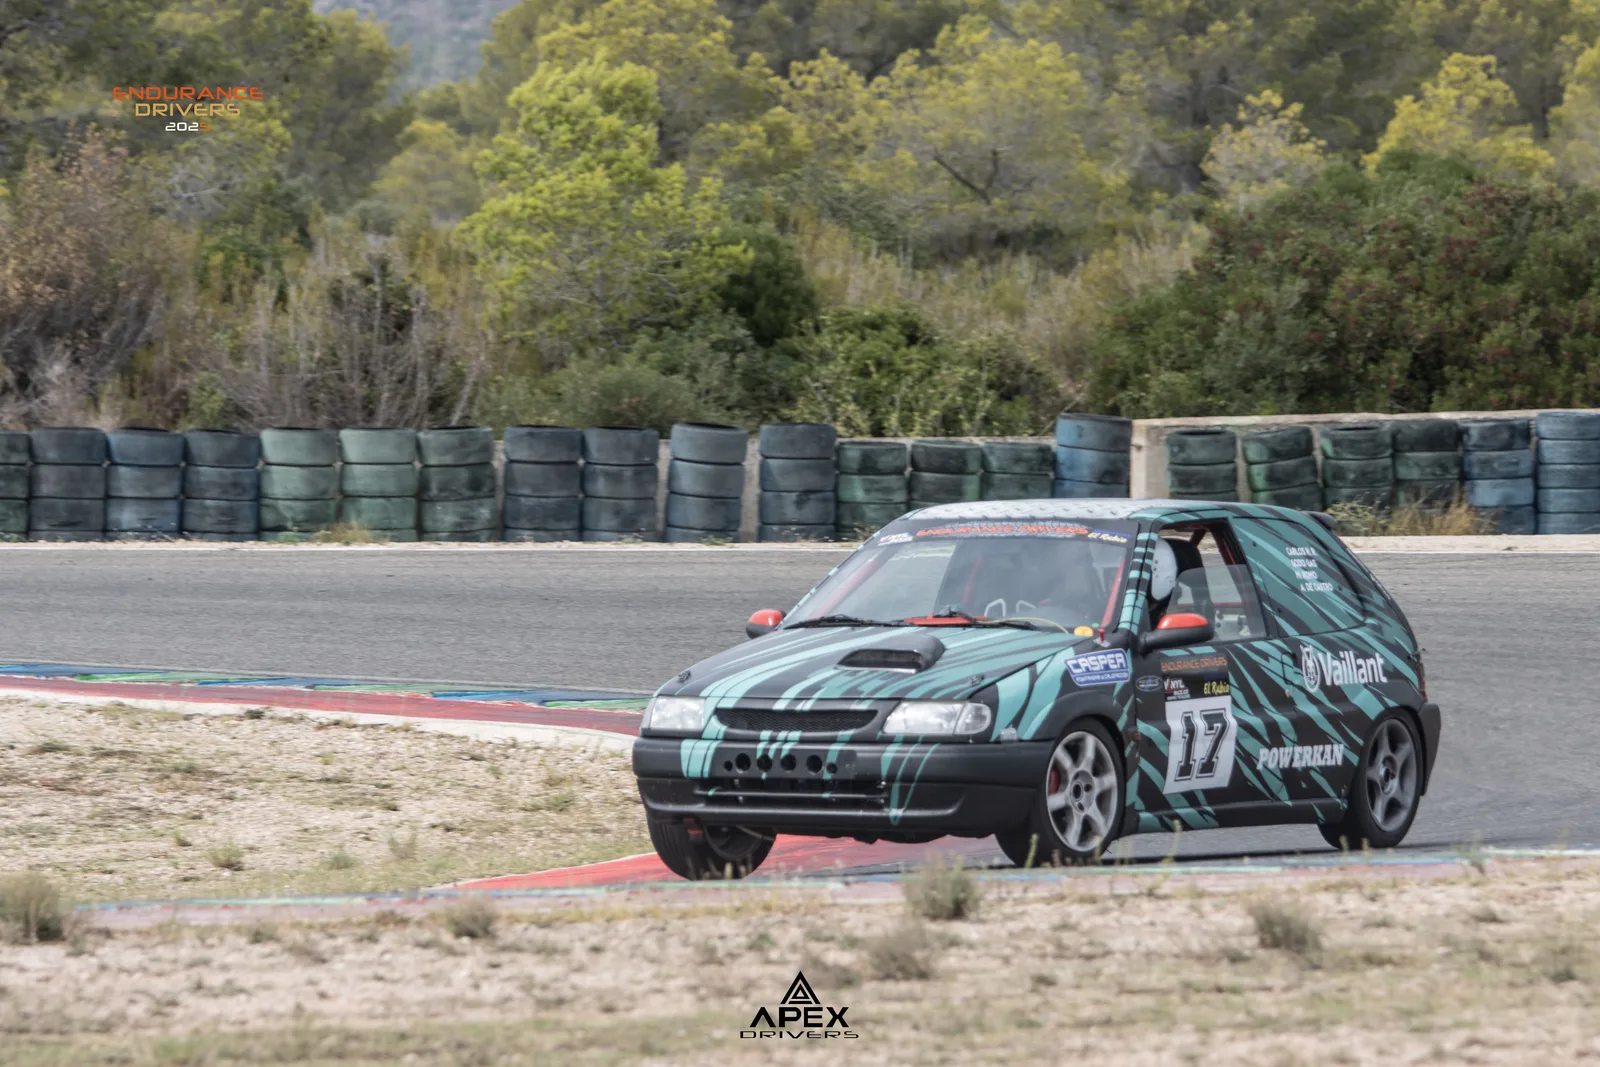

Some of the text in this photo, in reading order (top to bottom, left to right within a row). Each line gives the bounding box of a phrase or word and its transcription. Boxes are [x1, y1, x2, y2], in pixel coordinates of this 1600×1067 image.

[916, 525, 1014, 537] ENDURANCE
[1017, 525, 1088, 535] DRIVERS
[1305, 583, 1314, 591] DE
[1313, 583, 1333, 591] CASTRO
[1067, 653, 1126, 673] CASPER
[1317, 651, 1388, 686] Vaillant
[1174, 708, 1230, 782] 17
[1256, 744, 1345, 770] POWERKAN
